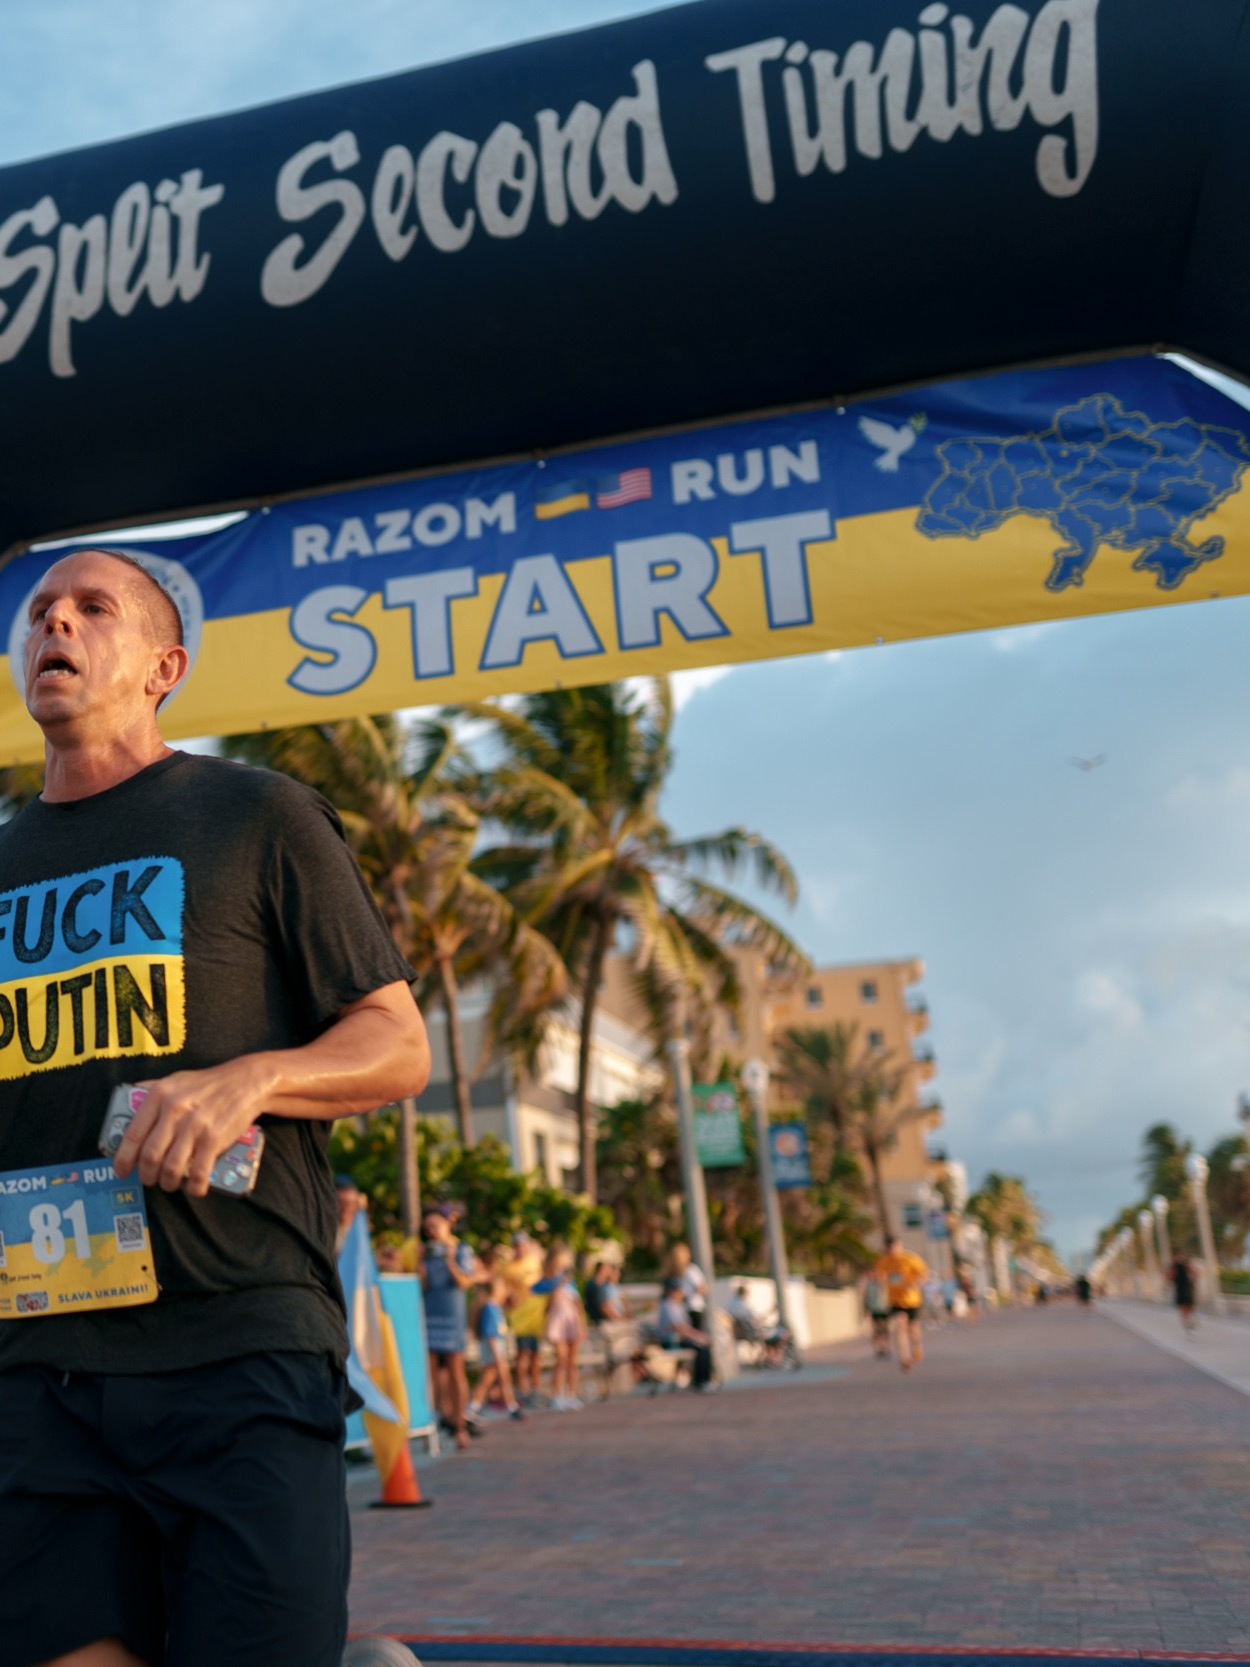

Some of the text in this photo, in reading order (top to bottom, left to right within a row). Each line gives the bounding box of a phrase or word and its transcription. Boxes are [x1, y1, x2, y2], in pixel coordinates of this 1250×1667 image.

[261, 60, 677, 308] Second
[705, 0, 1099, 202] Timing
[292, 440, 821, 568] RAZOM RUN
[286, 508, 837, 696] START
[28, 1199, 91, 1265] 81
[116, 1192, 134, 1204] 5K
[58, 1291, 93, 1304] SLAVA
